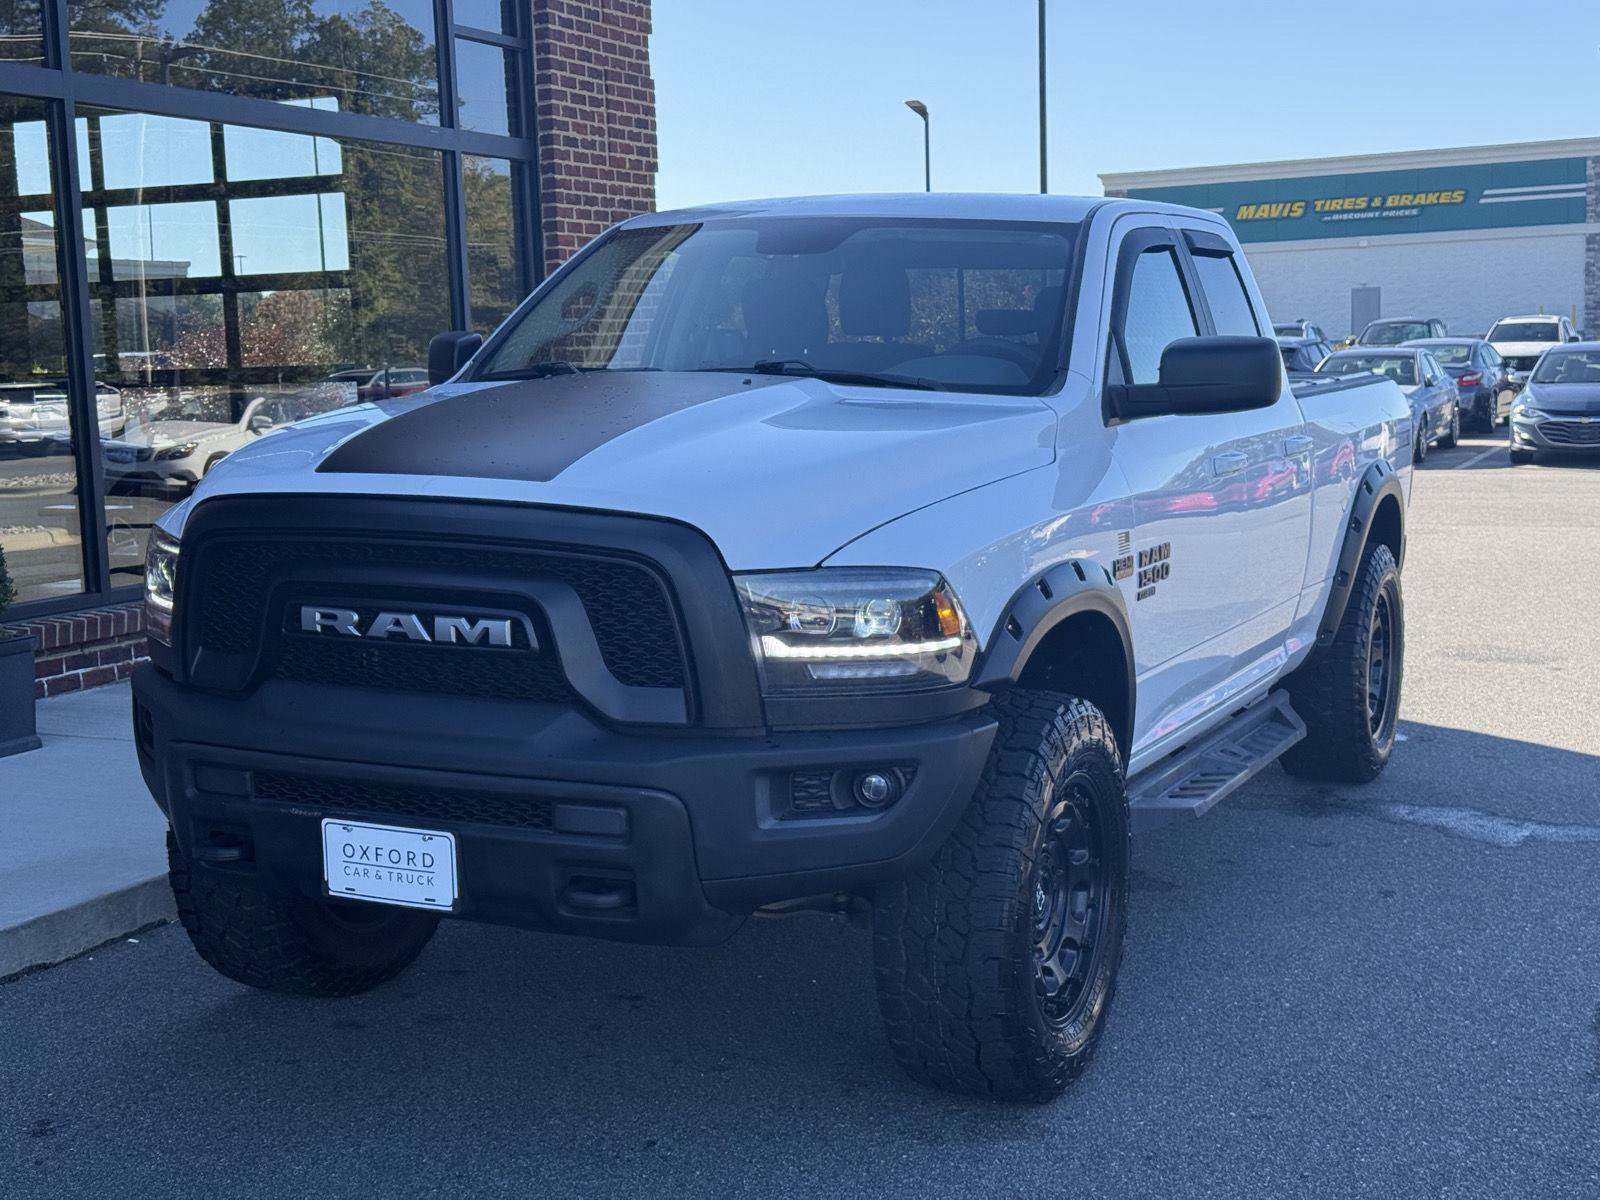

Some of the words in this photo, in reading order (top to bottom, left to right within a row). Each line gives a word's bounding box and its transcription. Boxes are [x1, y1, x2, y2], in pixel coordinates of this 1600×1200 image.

[1236, 201, 1304, 220] MAVIS
[1314, 197, 1368, 212] TIRES
[1372, 197, 1381, 208] &
[1386, 190, 1465, 207] BRAKES
[1332, 211, 1380, 220] DISCOUNT
[1382, 208, 1418, 217] PRICES
[1138, 542, 1170, 568] RAM
[1138, 562, 1170, 588] 1500
[301, 606, 512, 647] RAM
[343, 843, 435, 868] OXFORD
[343, 864, 369, 878] CAR
[374, 870, 383, 880] &
[387, 871, 435, 887] TRUCK
